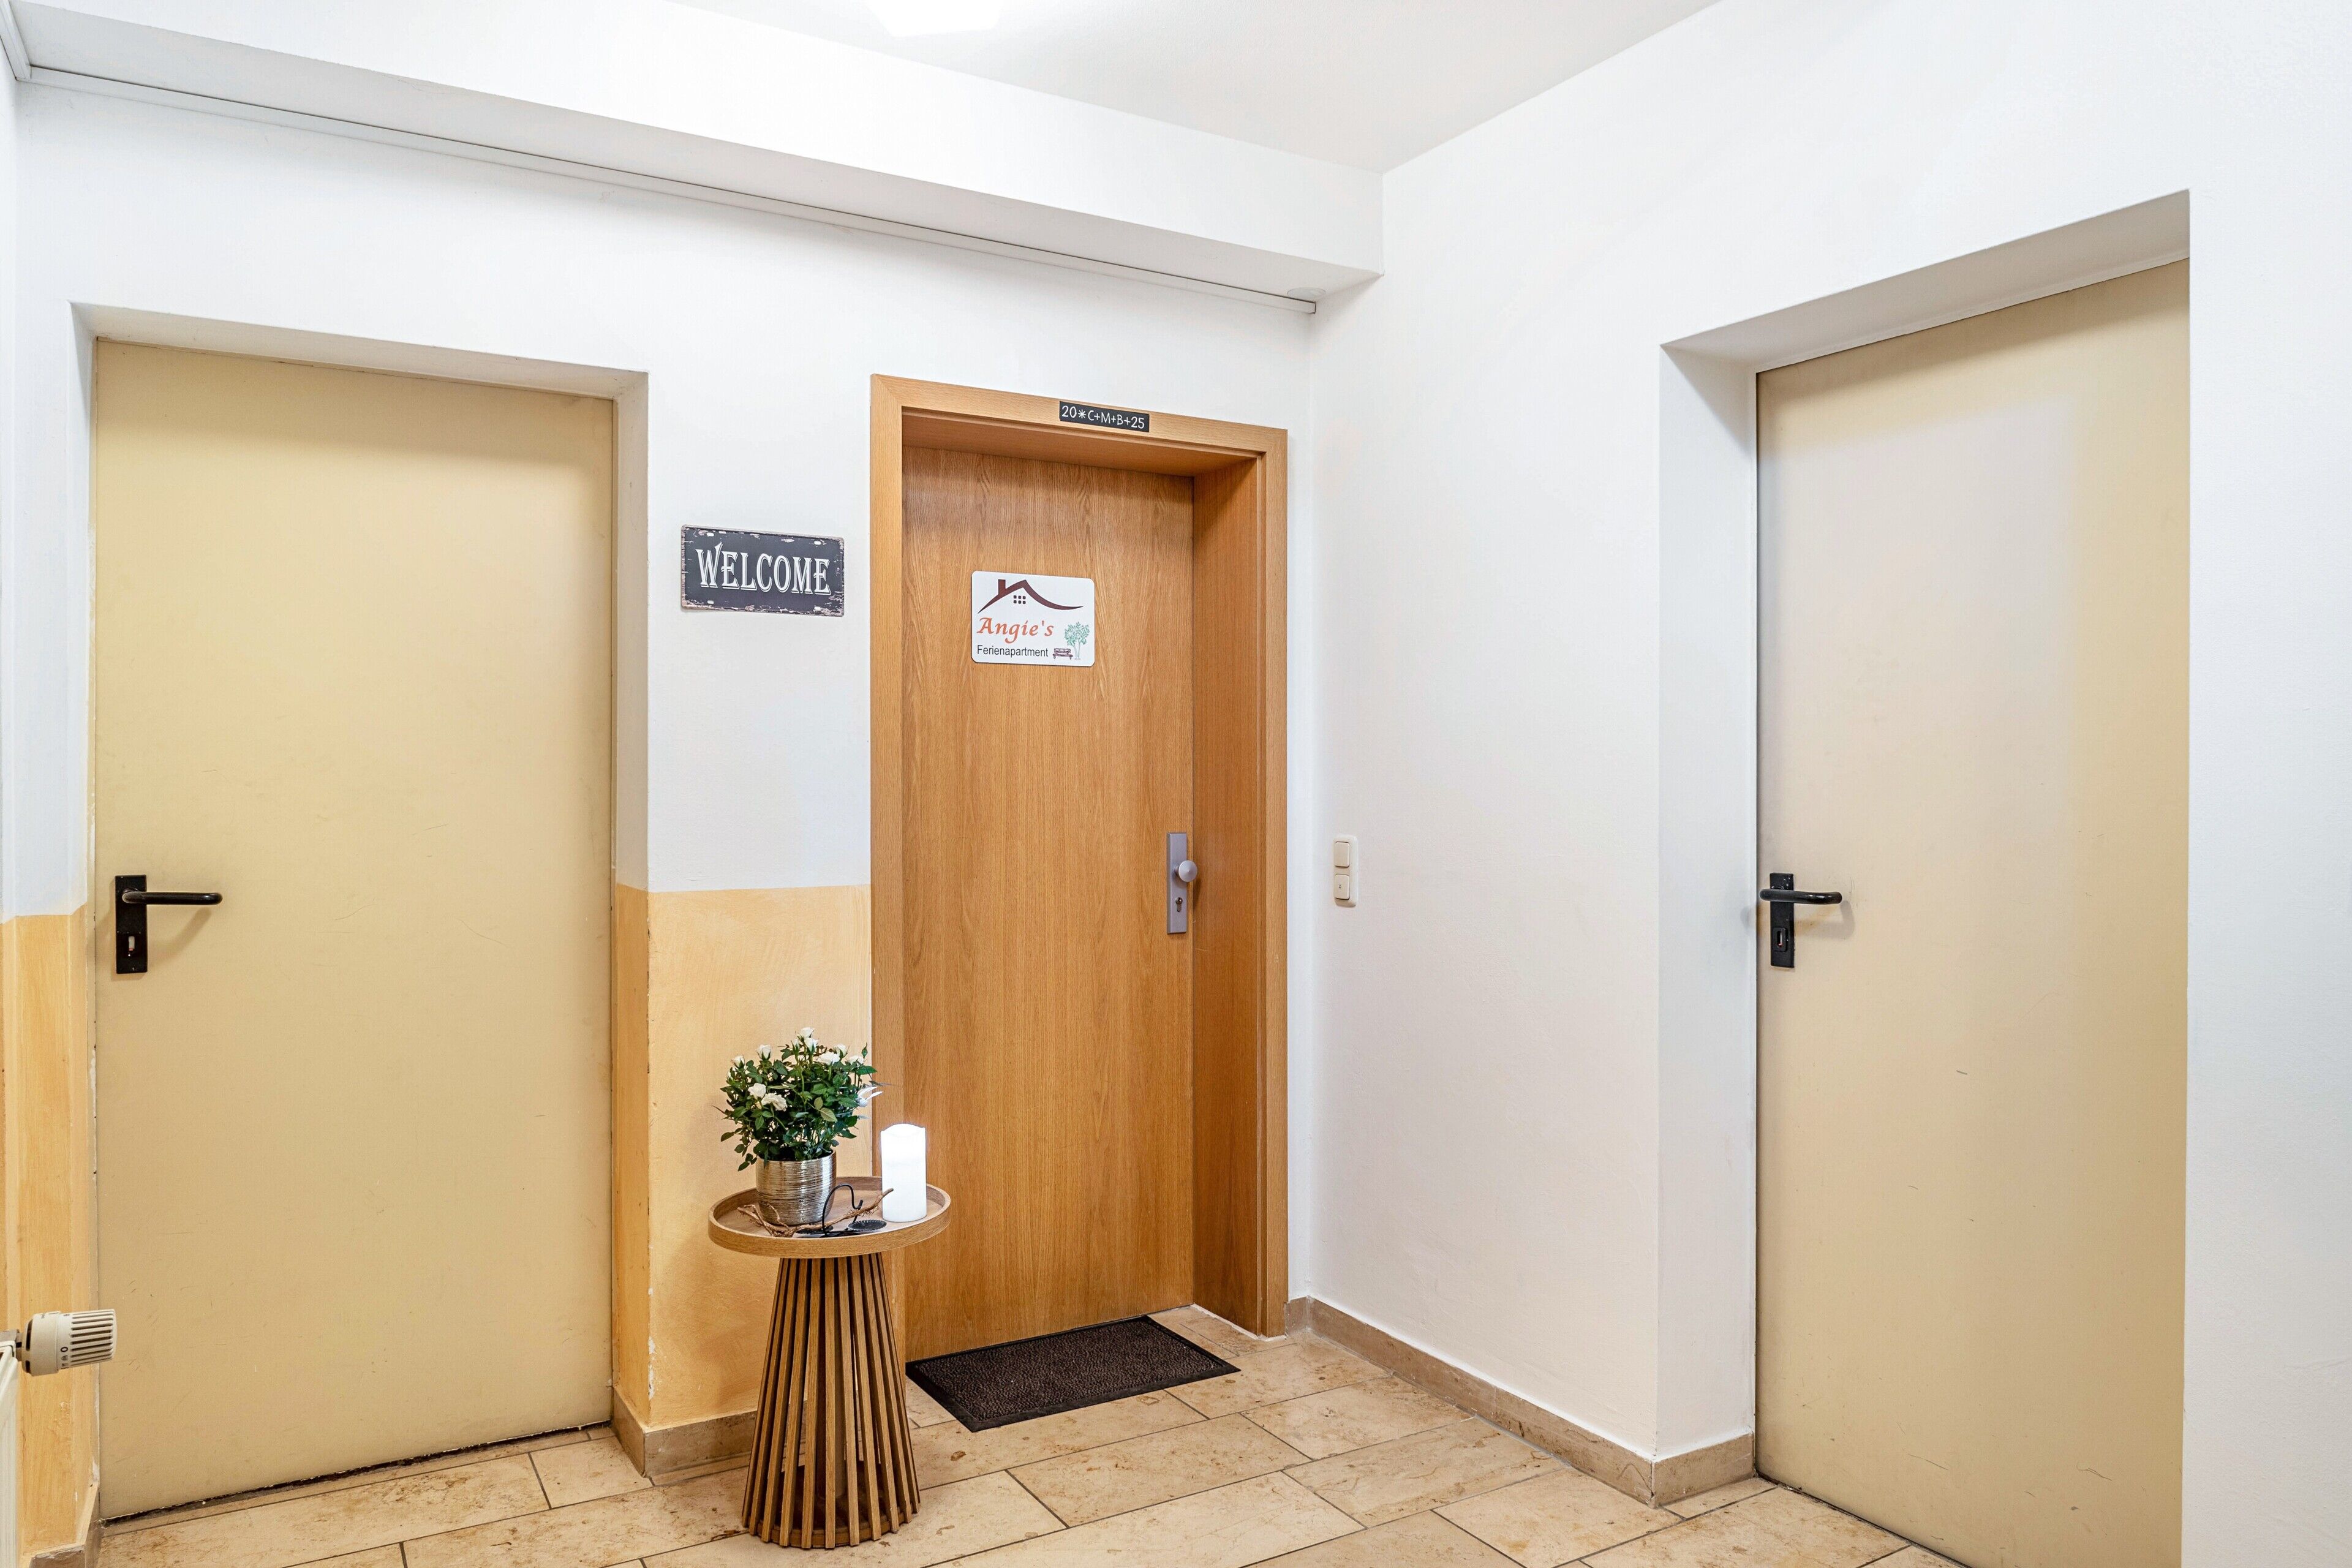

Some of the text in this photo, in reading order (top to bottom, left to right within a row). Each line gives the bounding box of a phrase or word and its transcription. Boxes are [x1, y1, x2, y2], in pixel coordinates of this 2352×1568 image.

[695, 541, 832, 595] WELCOME
[976, 617, 1054, 644] Angie's
[977, 644, 1049, 658] Ferienapartment
